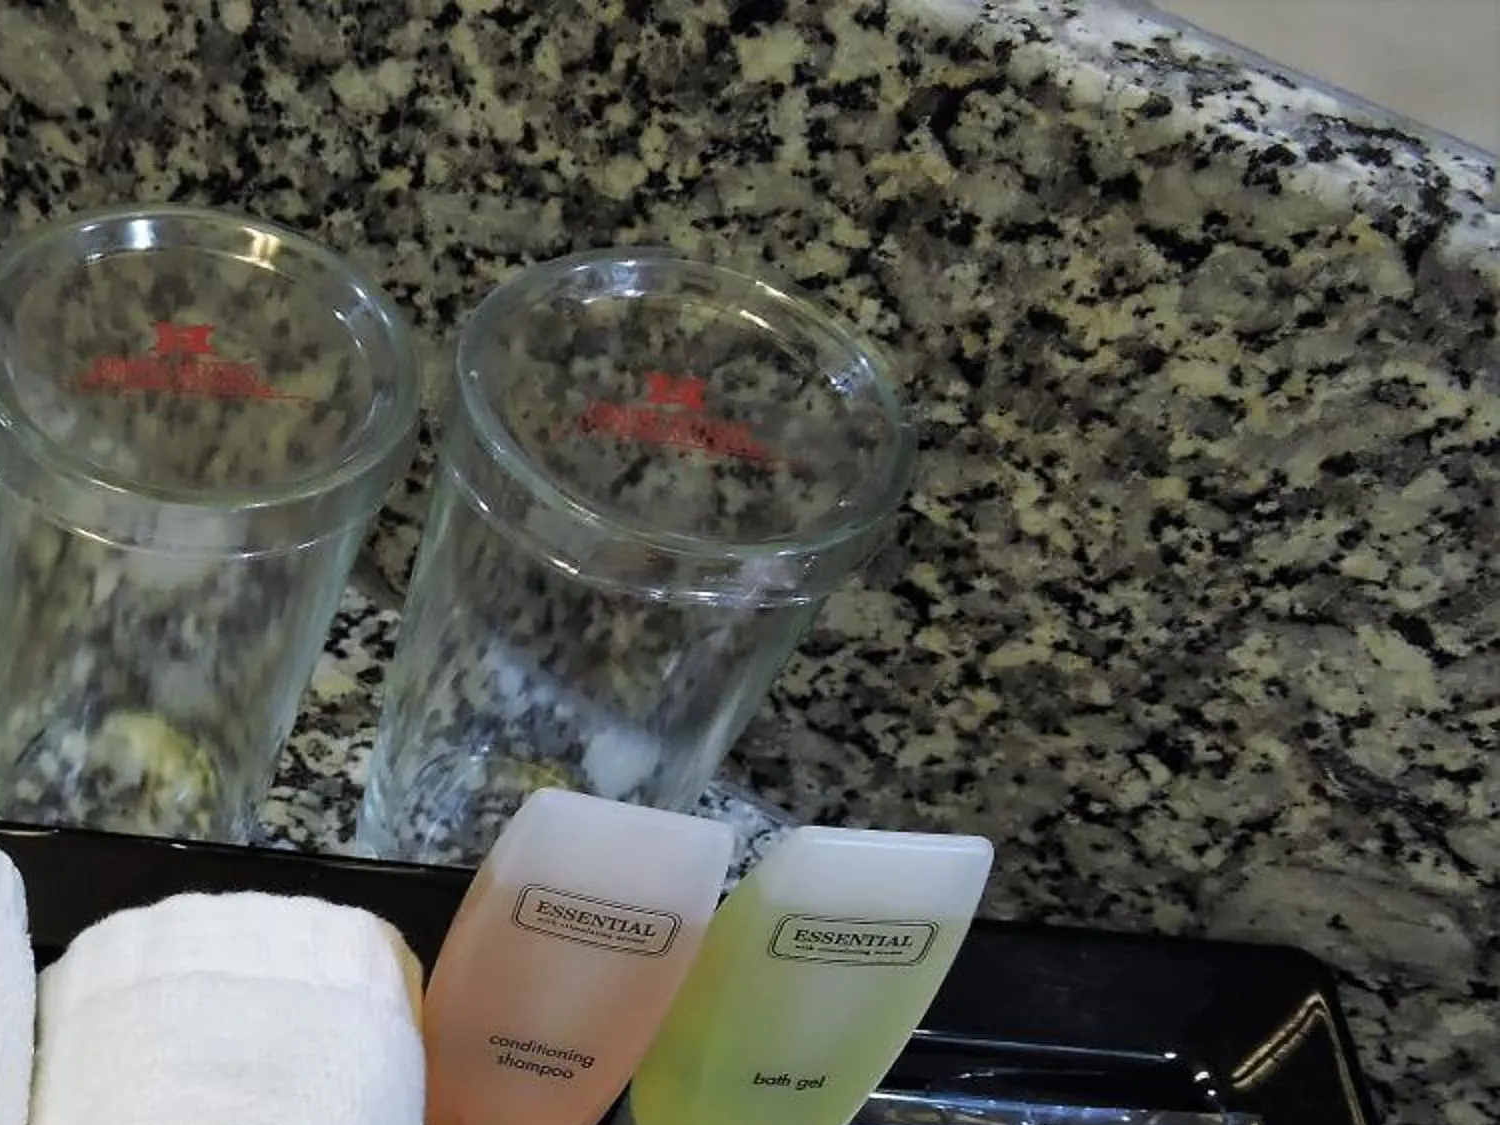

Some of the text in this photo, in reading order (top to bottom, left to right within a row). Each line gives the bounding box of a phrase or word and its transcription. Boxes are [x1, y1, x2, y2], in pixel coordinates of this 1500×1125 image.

[535, 900, 657, 937] ESSENTIAL
[793, 929, 913, 947] ESSENTIAL
[489, 1035, 595, 1068] conditioning
[498, 1052, 574, 1079] shampoo
[753, 1072, 826, 1090] bath gel
